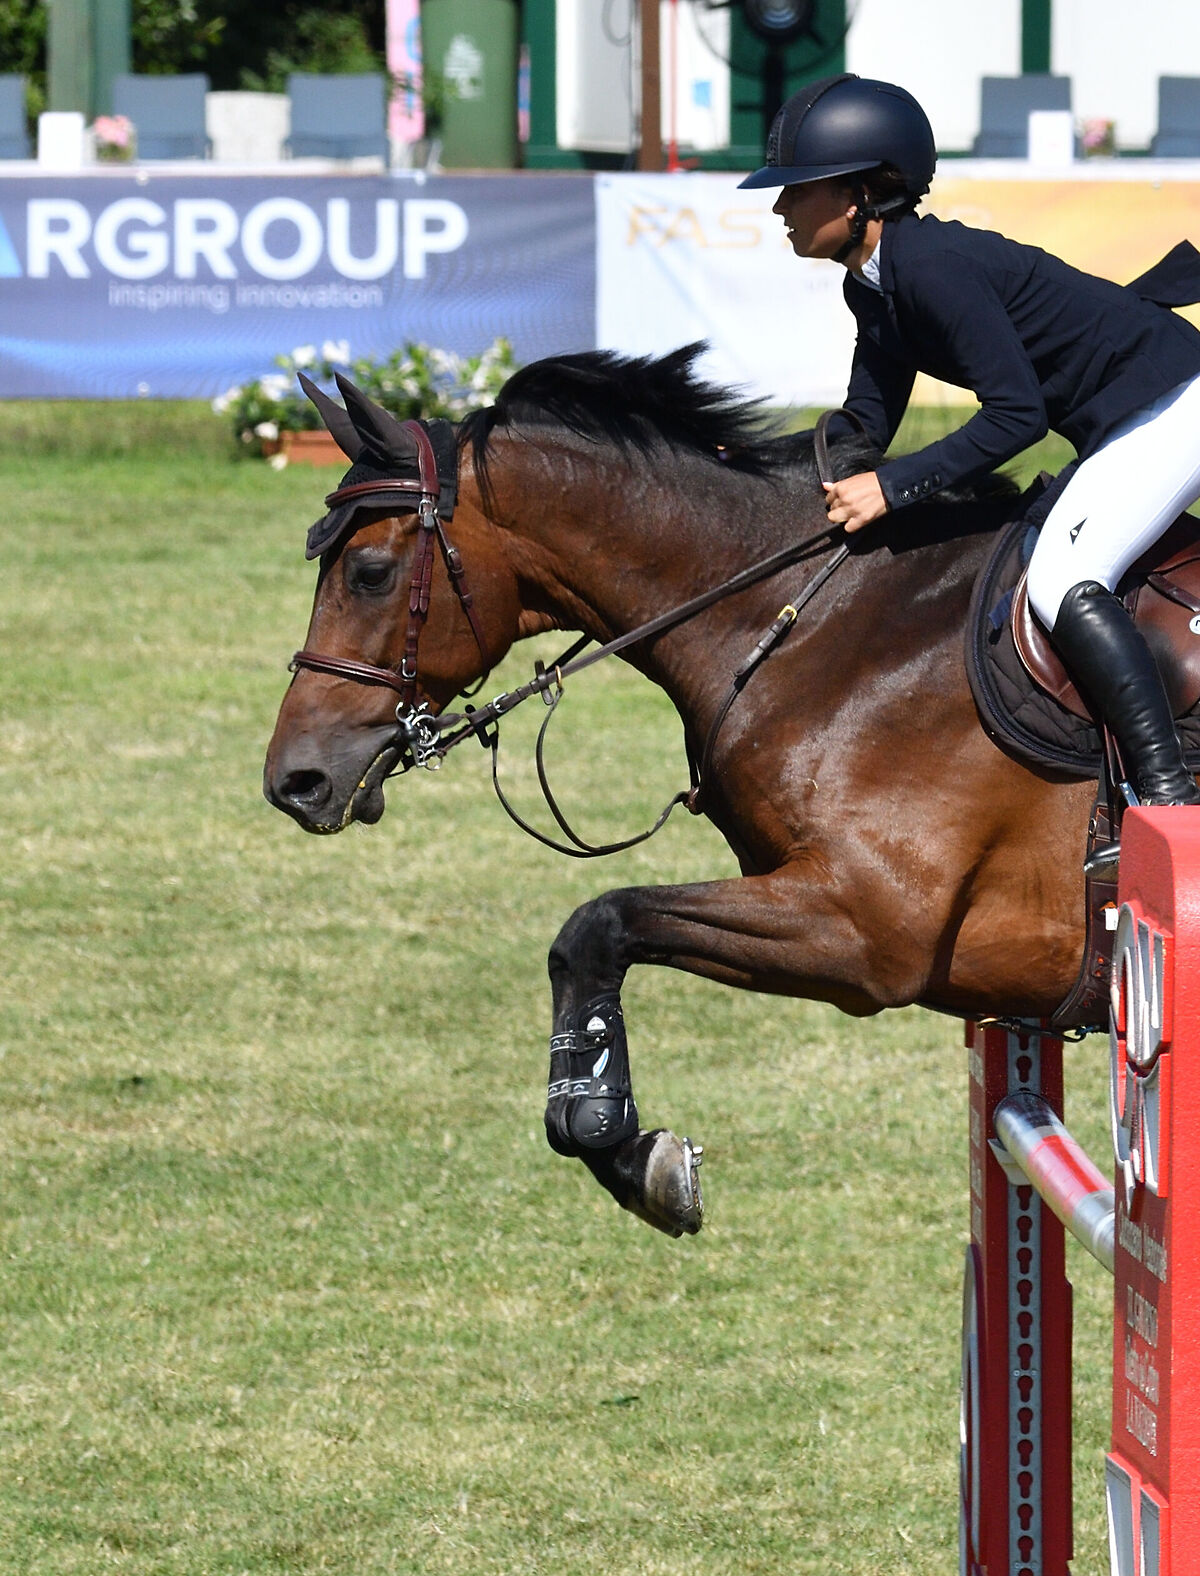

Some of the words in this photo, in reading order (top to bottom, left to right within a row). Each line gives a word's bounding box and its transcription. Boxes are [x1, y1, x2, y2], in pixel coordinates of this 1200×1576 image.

[626, 206, 796, 249] FAS
[109, 281, 230, 314] inspiring
[237, 280, 384, 308] innovation
